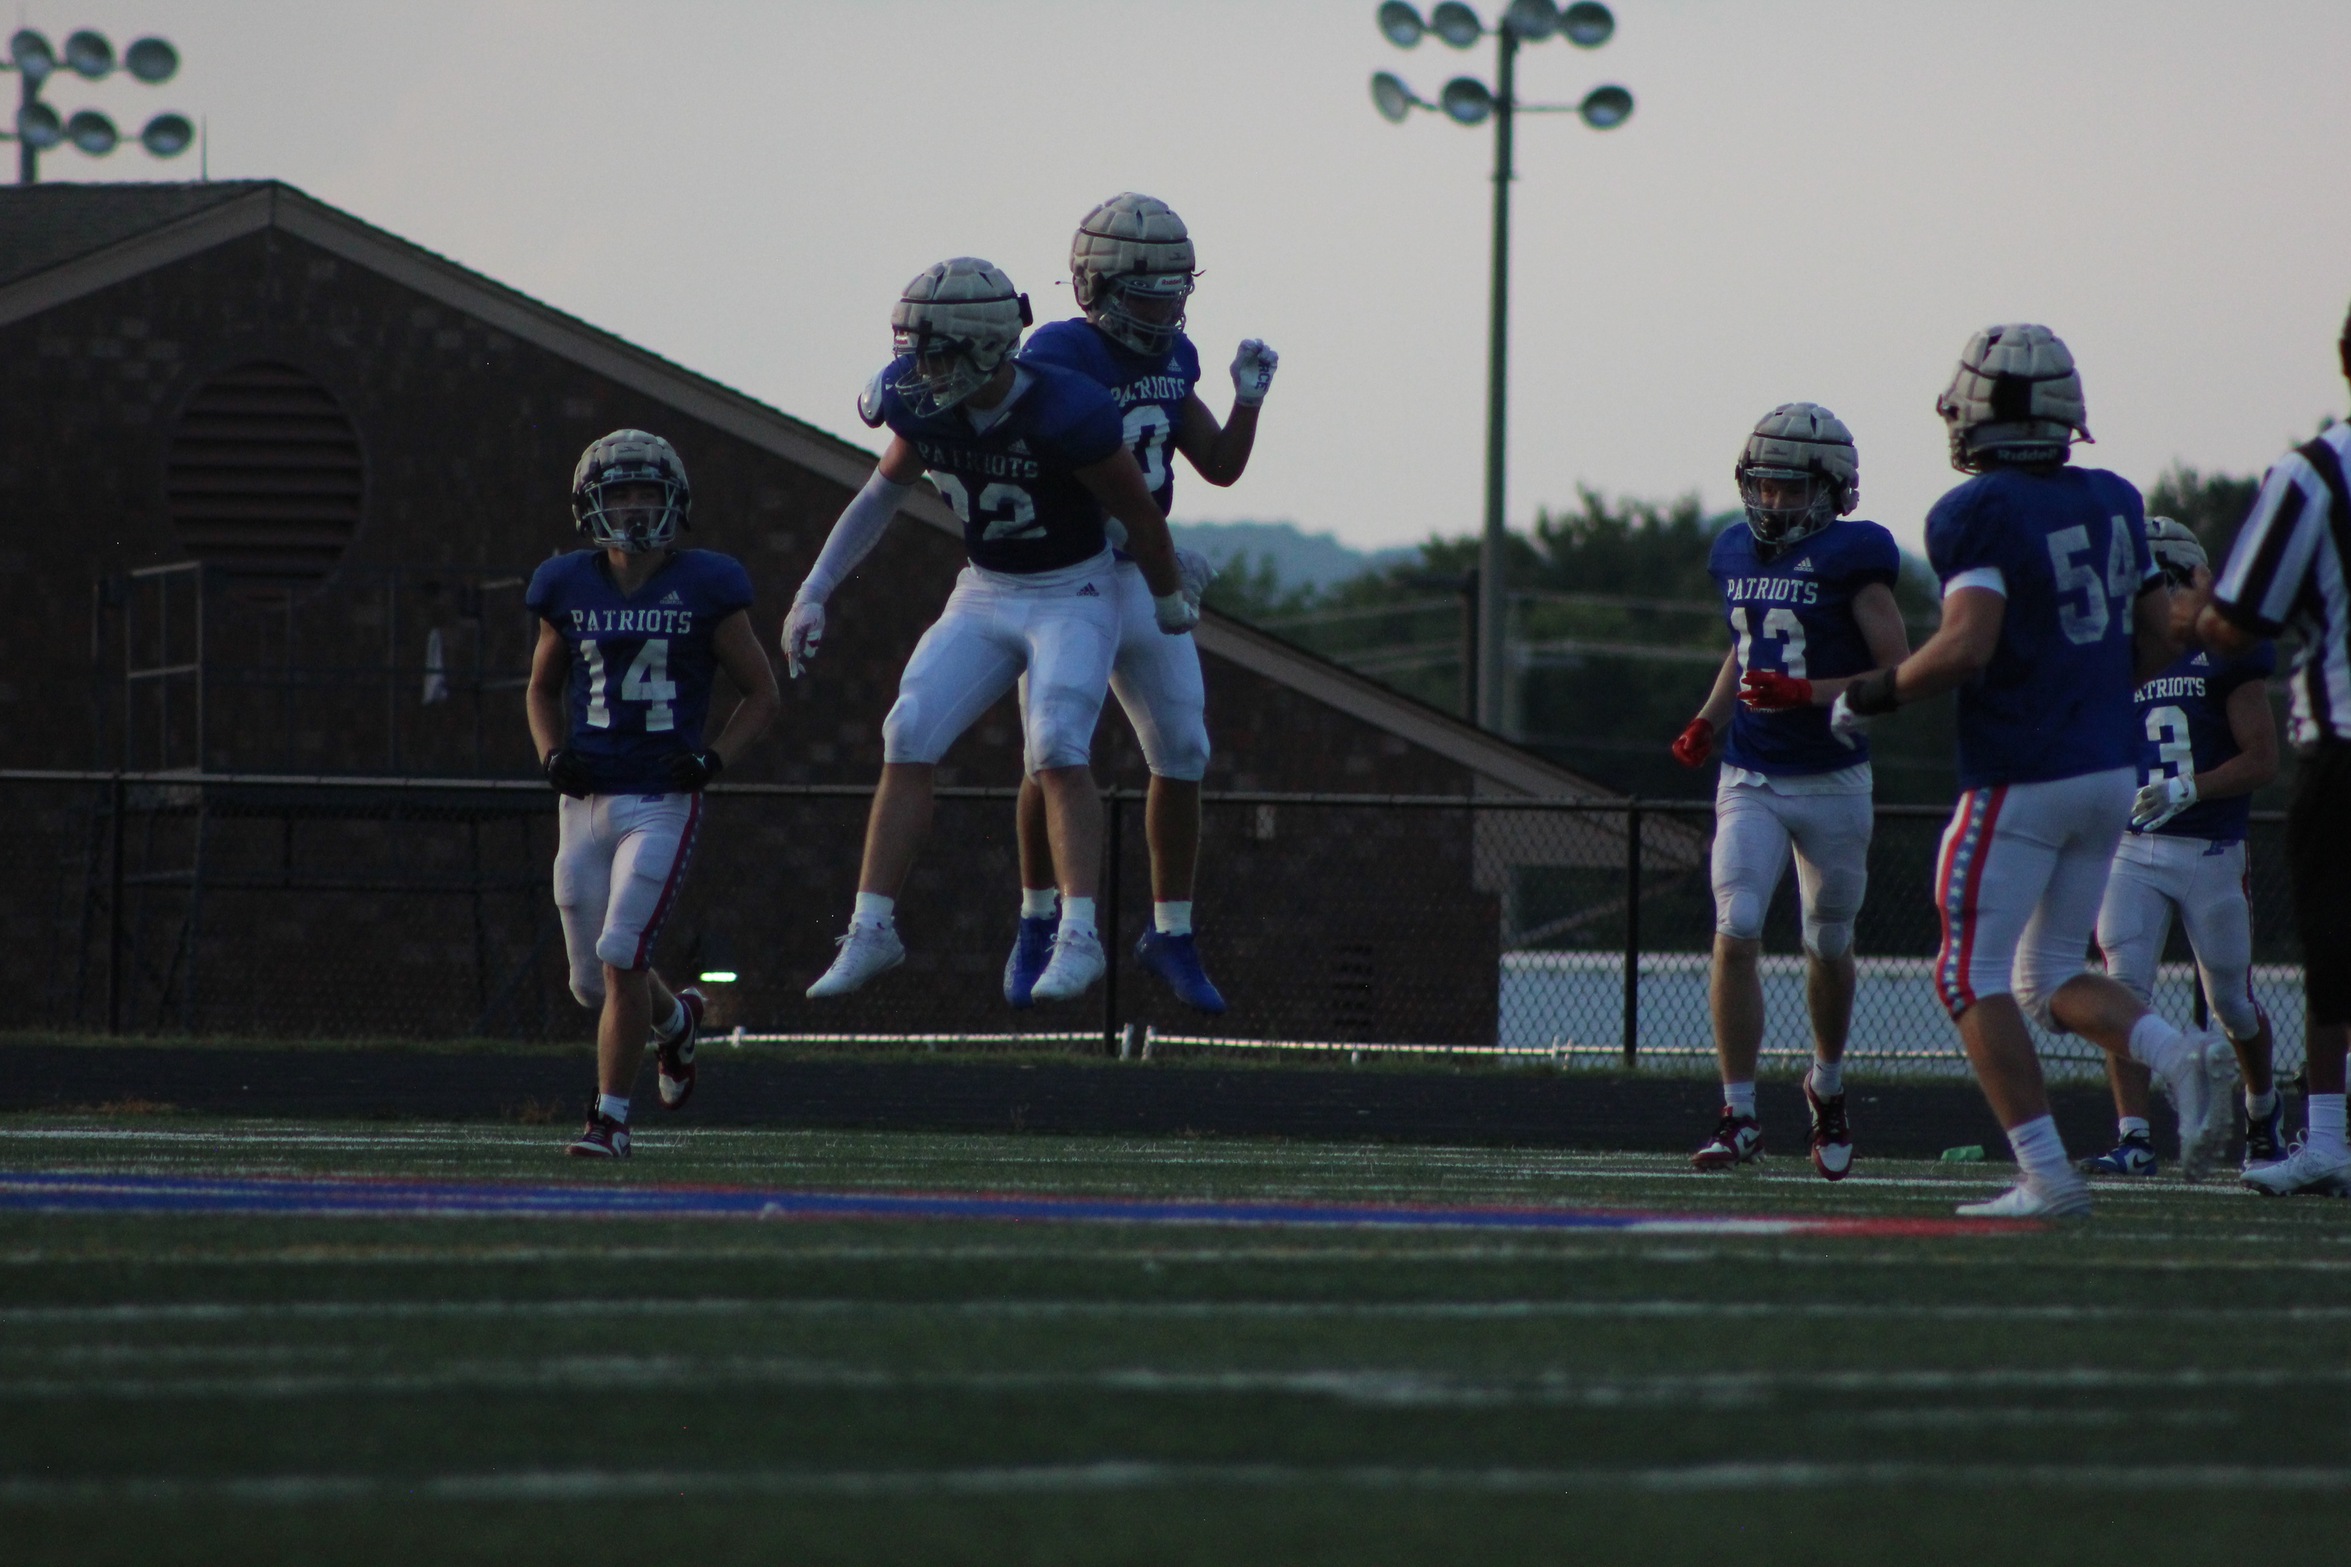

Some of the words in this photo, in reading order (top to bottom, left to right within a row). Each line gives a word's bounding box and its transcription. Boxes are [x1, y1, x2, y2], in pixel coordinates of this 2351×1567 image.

[1110, 375, 1185, 407] PATRIOTS
[1122, 404, 1170, 493] 0
[1727, 577, 1819, 605] PATRIOTS
[2045, 514, 2143, 646] 54
[570, 609, 693, 634] PATRIOTS
[1730, 607, 1807, 705] 13
[580, 639, 677, 732] 14
[2133, 676, 2206, 703] ATRIOTS
[2145, 704, 2195, 784] 3
